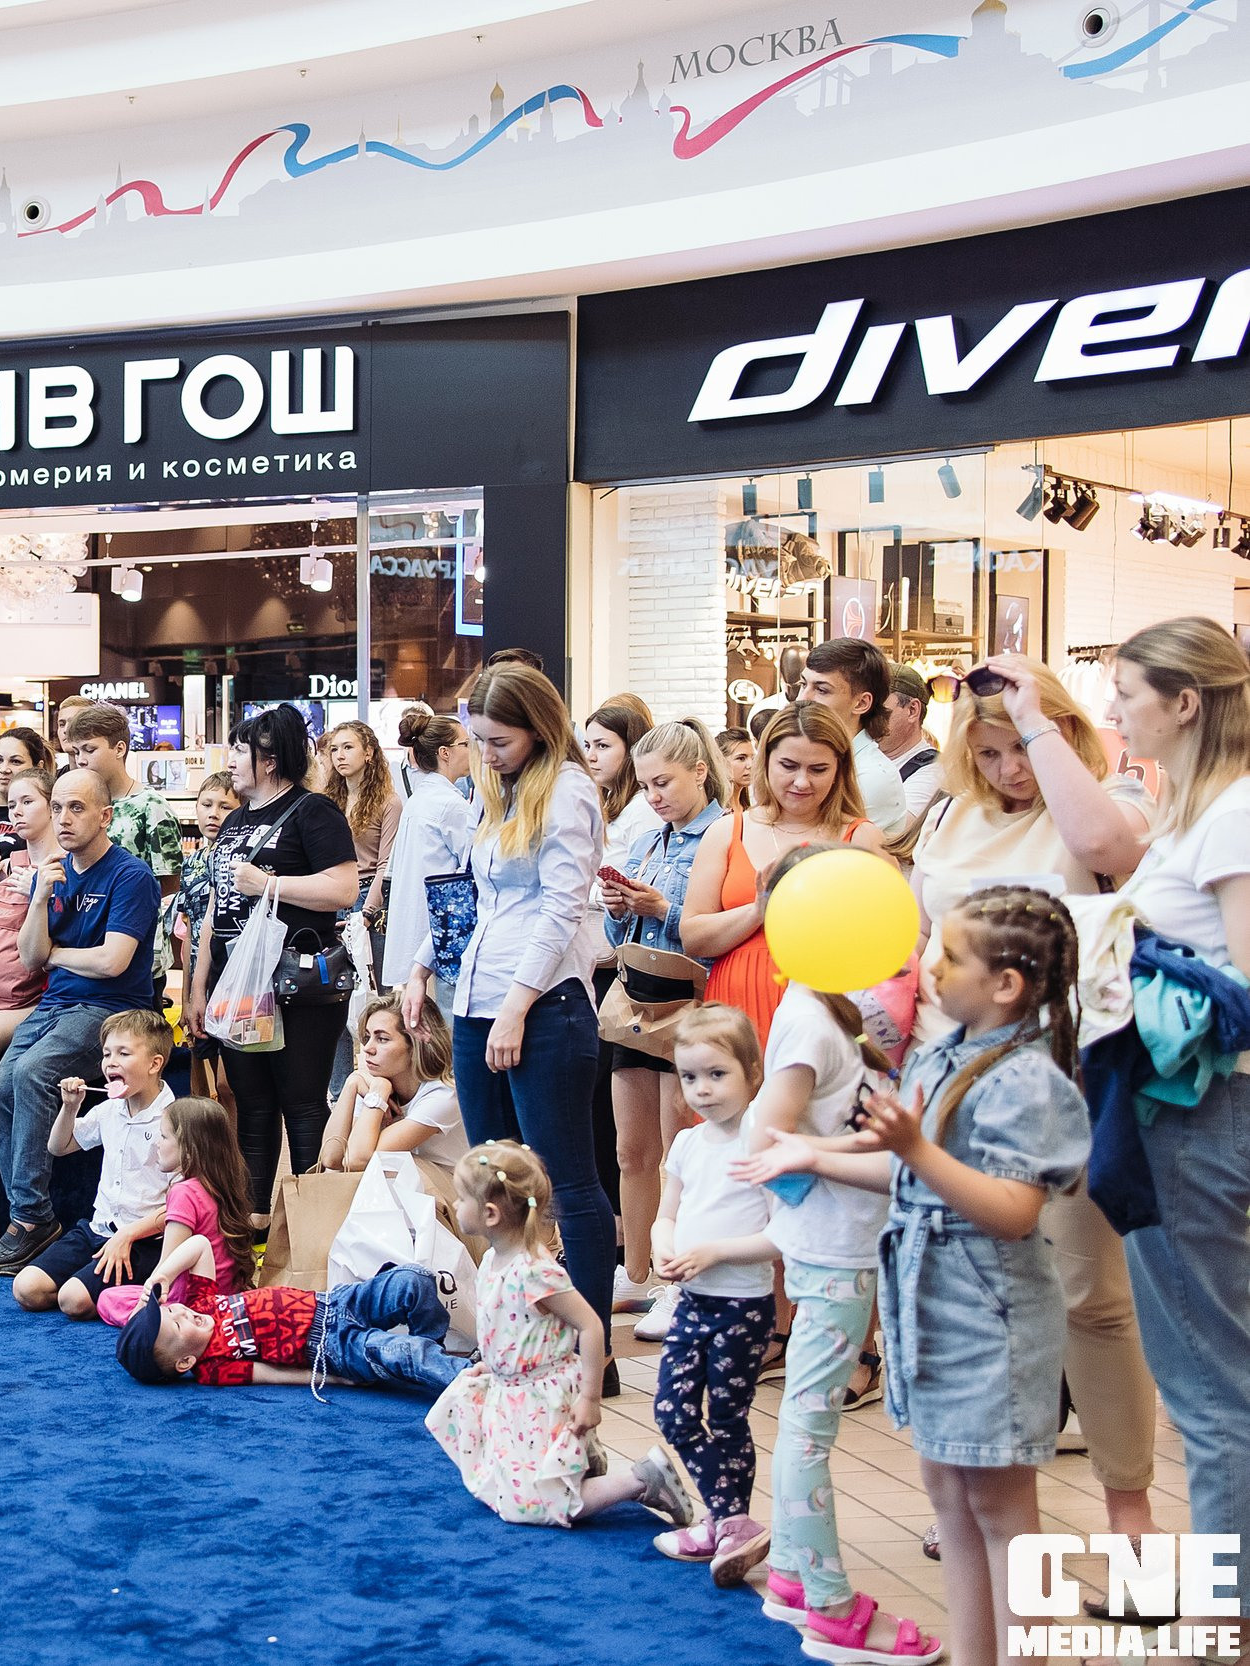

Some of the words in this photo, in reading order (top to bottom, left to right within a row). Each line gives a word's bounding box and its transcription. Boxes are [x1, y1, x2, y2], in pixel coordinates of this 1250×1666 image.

[668, 17, 846, 85] МОСКВА
[123, 345, 356, 444] ГОШ
[129, 461, 147, 480] и
[162, 447, 358, 478] косметика
[79, 682, 150, 700] CHANEL
[228, 852, 245, 911] MAR
